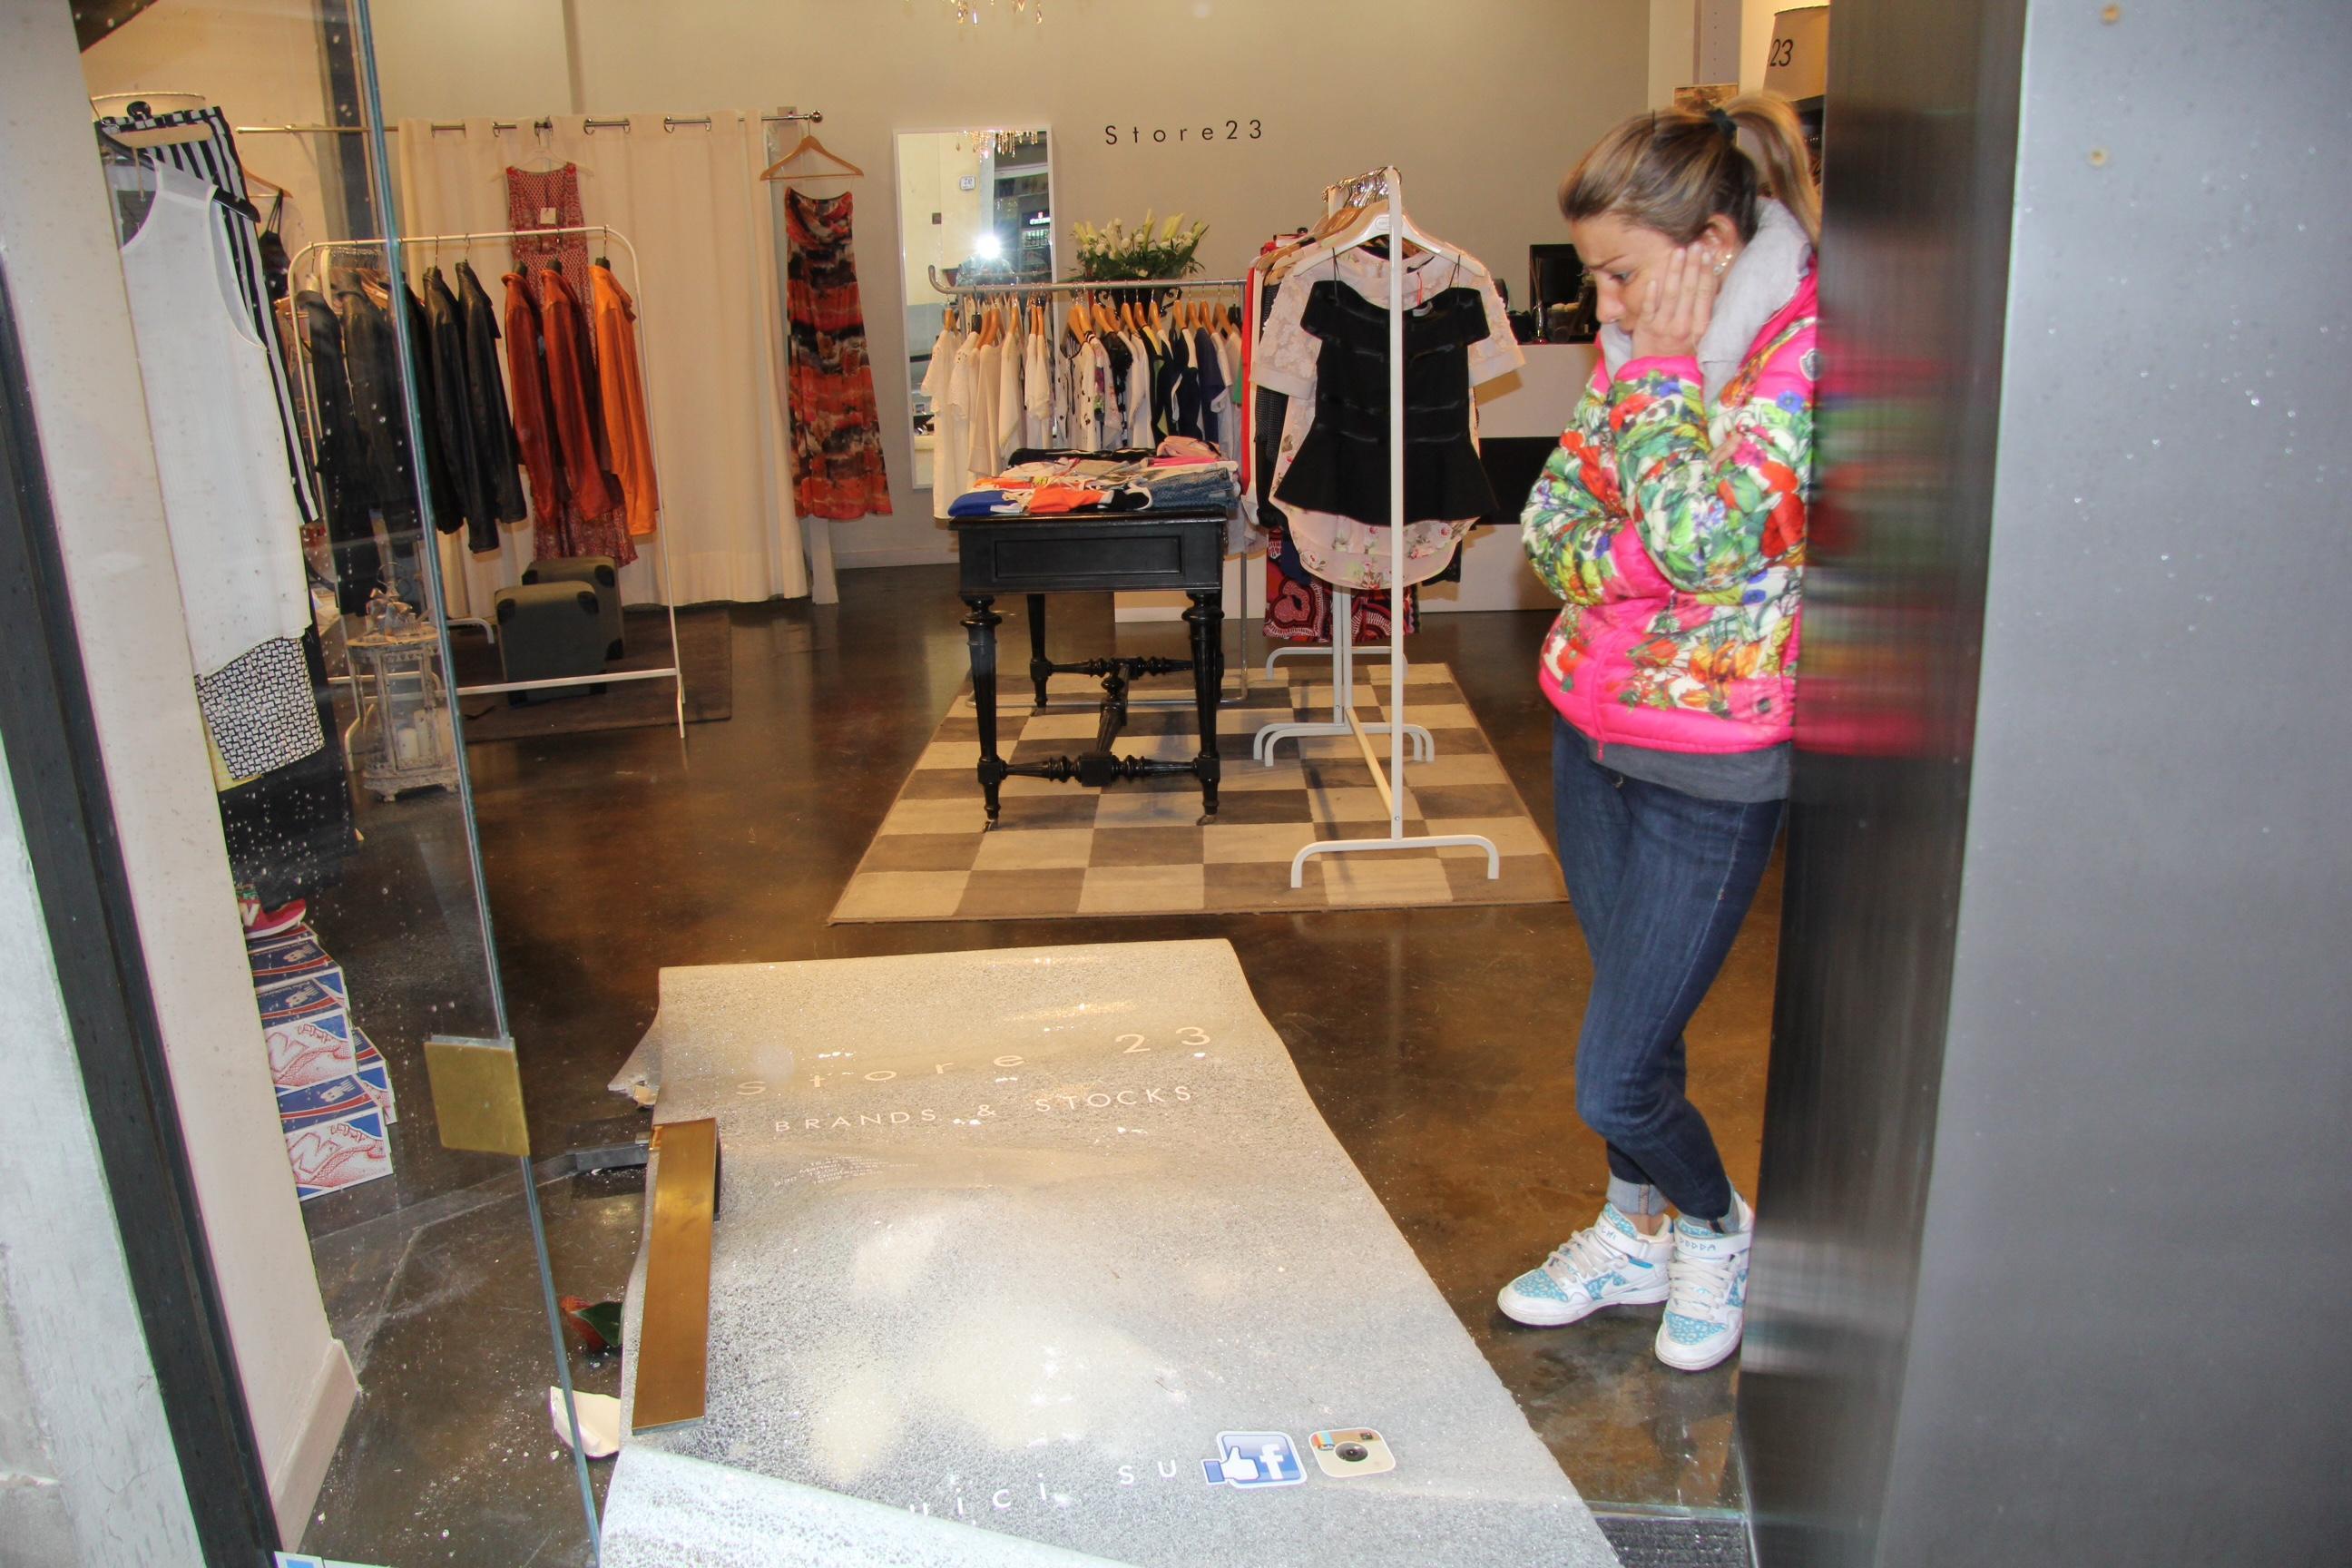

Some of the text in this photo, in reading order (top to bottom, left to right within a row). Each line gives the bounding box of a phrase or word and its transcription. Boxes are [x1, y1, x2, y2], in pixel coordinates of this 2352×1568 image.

[1769, 39, 1793, 66] 23
[1105, 119, 1261, 145] Store23
[736, 1026, 1210, 1095] Store 23
[775, 1086, 1191, 1132] BRANDS & STOCKS
